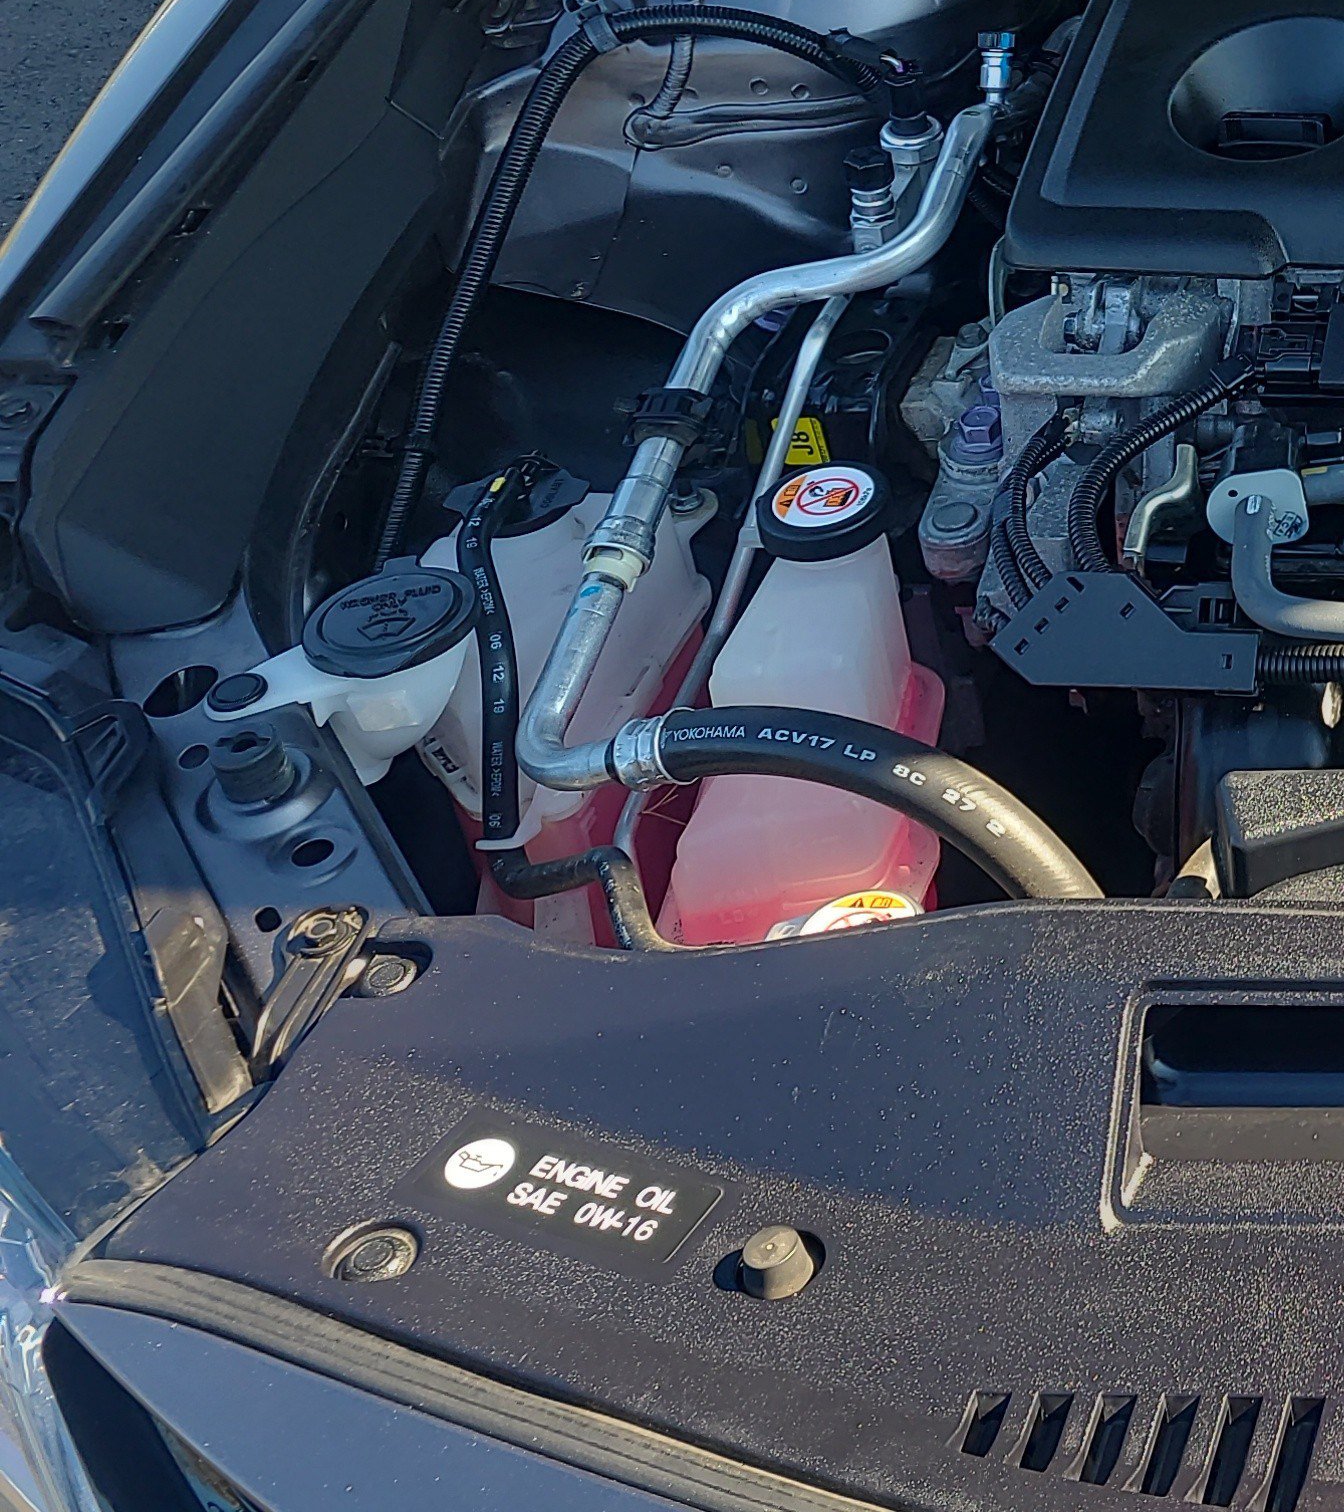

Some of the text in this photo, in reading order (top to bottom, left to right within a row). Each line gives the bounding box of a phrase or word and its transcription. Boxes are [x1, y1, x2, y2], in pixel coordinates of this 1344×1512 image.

[791, 431, 814, 456] J8
[404, 583, 442, 599] FLUID
[492, 663, 505, 683] 12
[493, 698, 505, 714] 19
[490, 740, 504, 767] WATER
[672, 725, 746, 742] YOKOHAMA
[757, 727, 837, 750] ACV17
[843, 744, 877, 762] LP
[892, 763, 927, 786] 8C
[941, 787, 977, 812] 27
[528, 1154, 678, 1215] ENGINE OIL
[506, 1182, 659, 1241] SAE 0W-16
